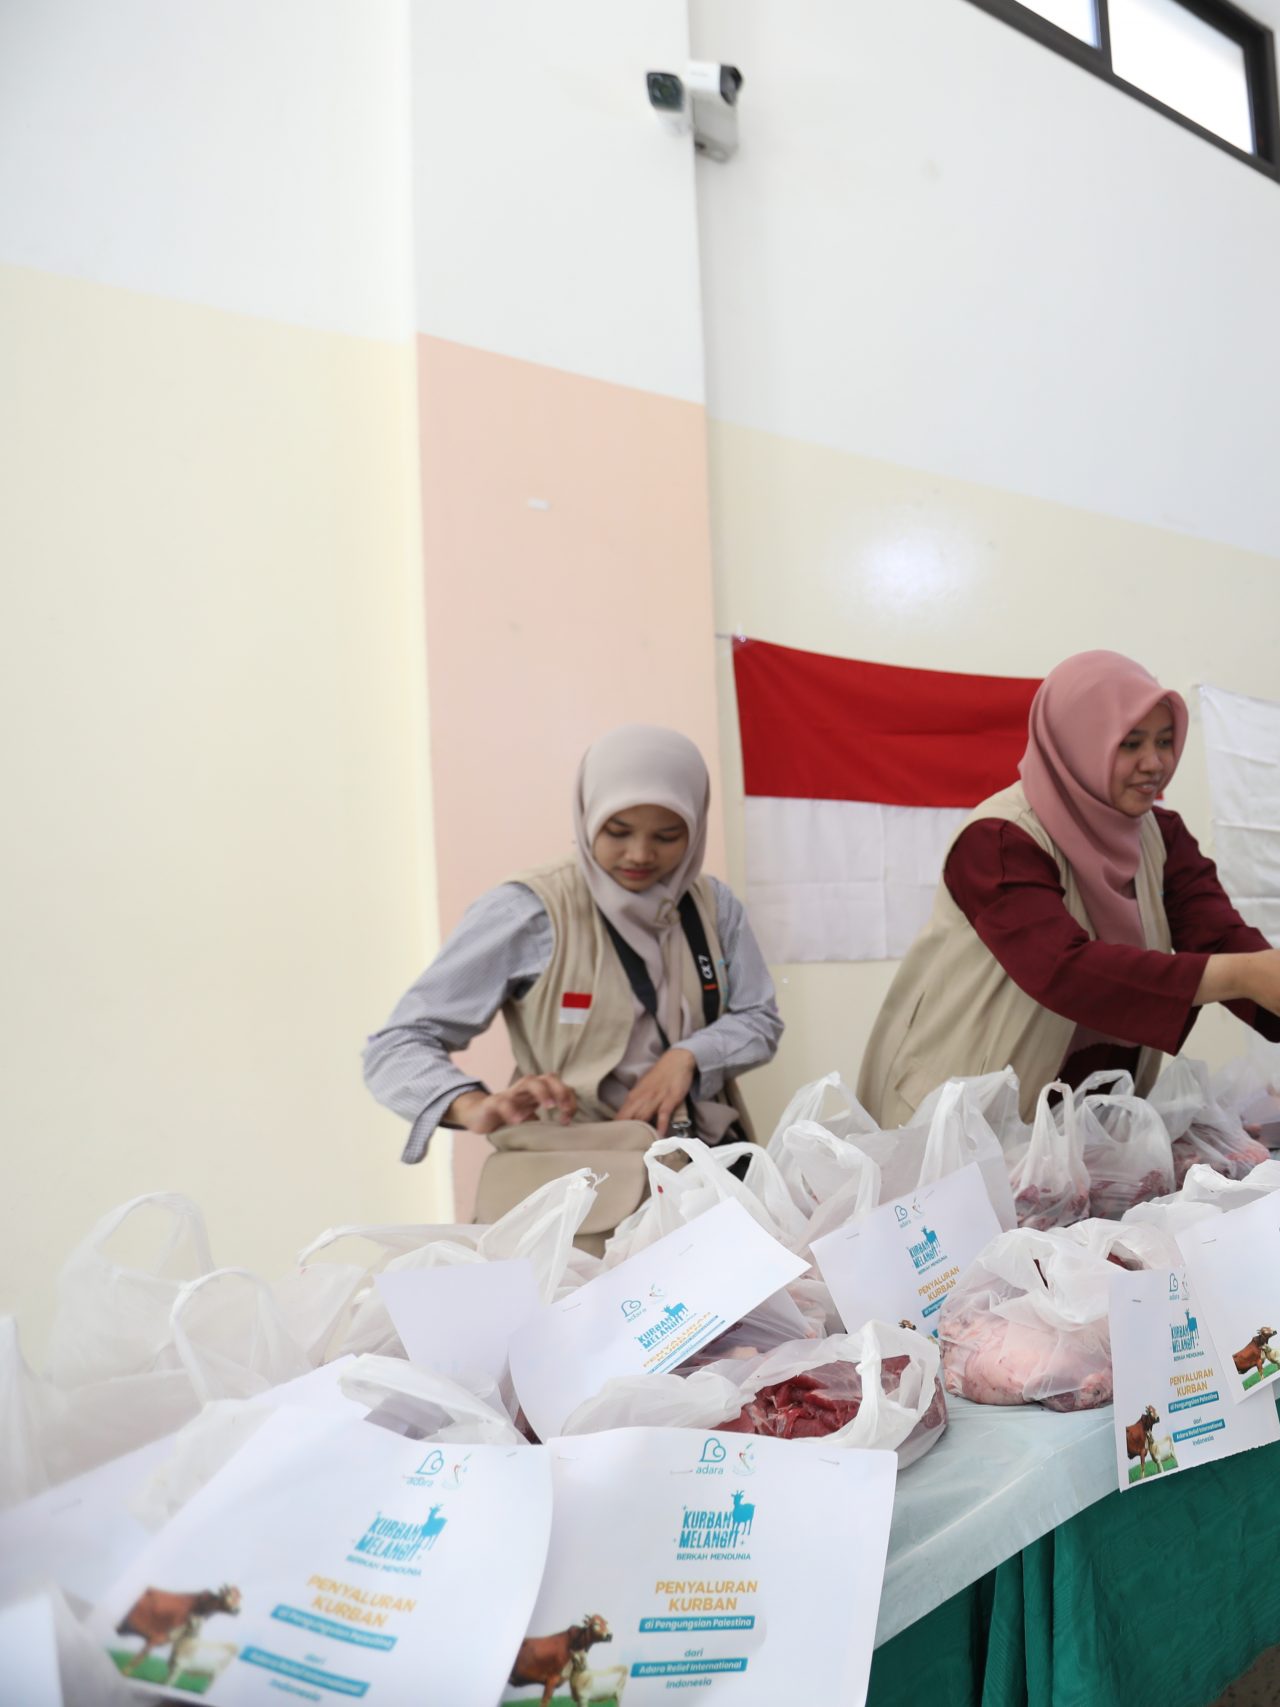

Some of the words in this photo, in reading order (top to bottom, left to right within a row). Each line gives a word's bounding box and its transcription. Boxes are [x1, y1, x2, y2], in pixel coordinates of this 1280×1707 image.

[918, 1265, 960, 1297] PENYALURAN
[927, 1278, 957, 1302] KURBAN
[637, 1314, 674, 1344] KURBAN
[1169, 1368, 1214, 1386] PENYALURAN
[1176, 1381, 1208, 1397] KURBAN
[695, 1464, 724, 1476] adara
[682, 1511, 734, 1529] KURBAN
[678, 1530, 740, 1549] MELANGIT
[676, 1553, 708, 1561] BERKAH
[710, 1553, 752, 1561] MENDUNIA
[307, 1574, 417, 1613] PENYALURAN
[655, 1580, 758, 1595] PENYALURAN
[311, 1595, 389, 1628] KURBAN
[668, 1597, 738, 1612] KURBAN
[655, 1618, 712, 1631] Pengungsian
[713, 1617, 752, 1628] Palestina
[684, 1648, 704, 1658] dari
[639, 1664, 666, 1674] Adara
[690, 1660, 742, 1672] International
[666, 1677, 712, 1689] Indonesia
